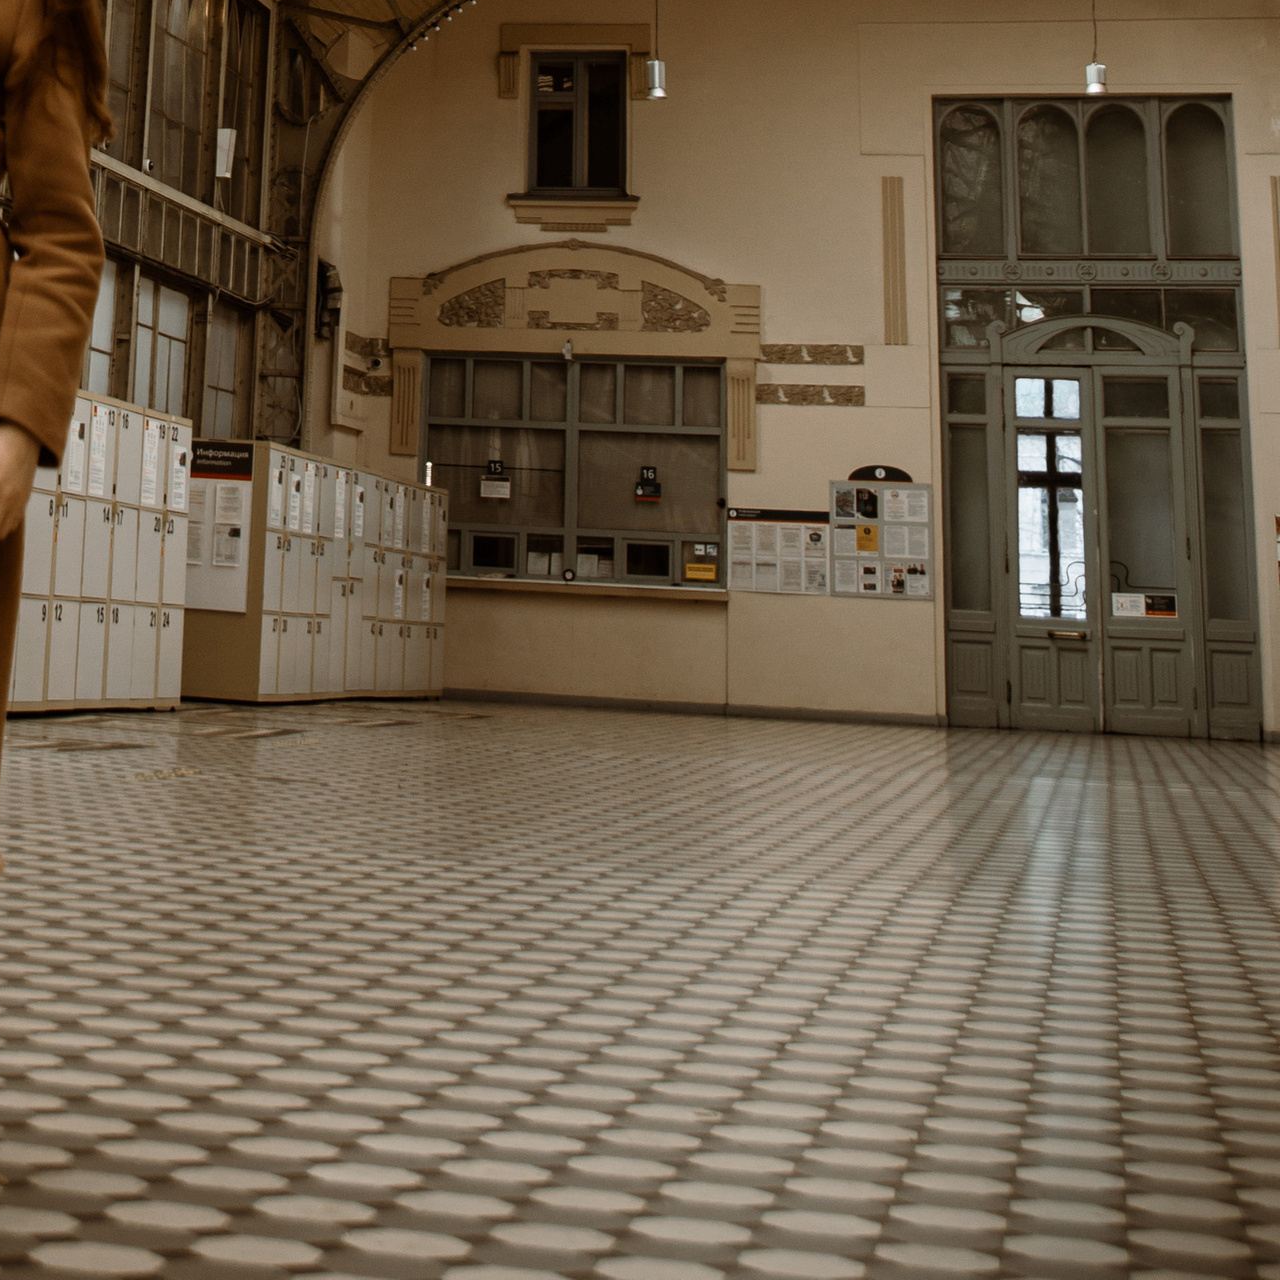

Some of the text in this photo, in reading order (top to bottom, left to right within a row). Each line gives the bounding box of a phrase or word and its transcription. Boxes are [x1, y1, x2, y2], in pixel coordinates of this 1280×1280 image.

[107, 409, 116, 427] 13
[122, 413, 130, 430] 16
[158, 423, 166, 440] 19
[171, 426, 179, 442] 22
[196, 447, 249, 460] Информация
[489, 462, 502, 473] 15
[642, 469, 655, 479] 16
[48, 498, 54, 517] 8
[102, 506, 110, 524] 14
[116, 509, 124, 526] 17
[153, 516, 161, 533] 20
[166, 519, 175, 534] 23
[41, 604, 47, 622] 9
[54, 604, 63, 621] 12
[96, 607, 104, 624] 15
[111, 608, 119, 624] 18
[150, 611, 157, 627] 21
[162, 612, 170, 628] 24
